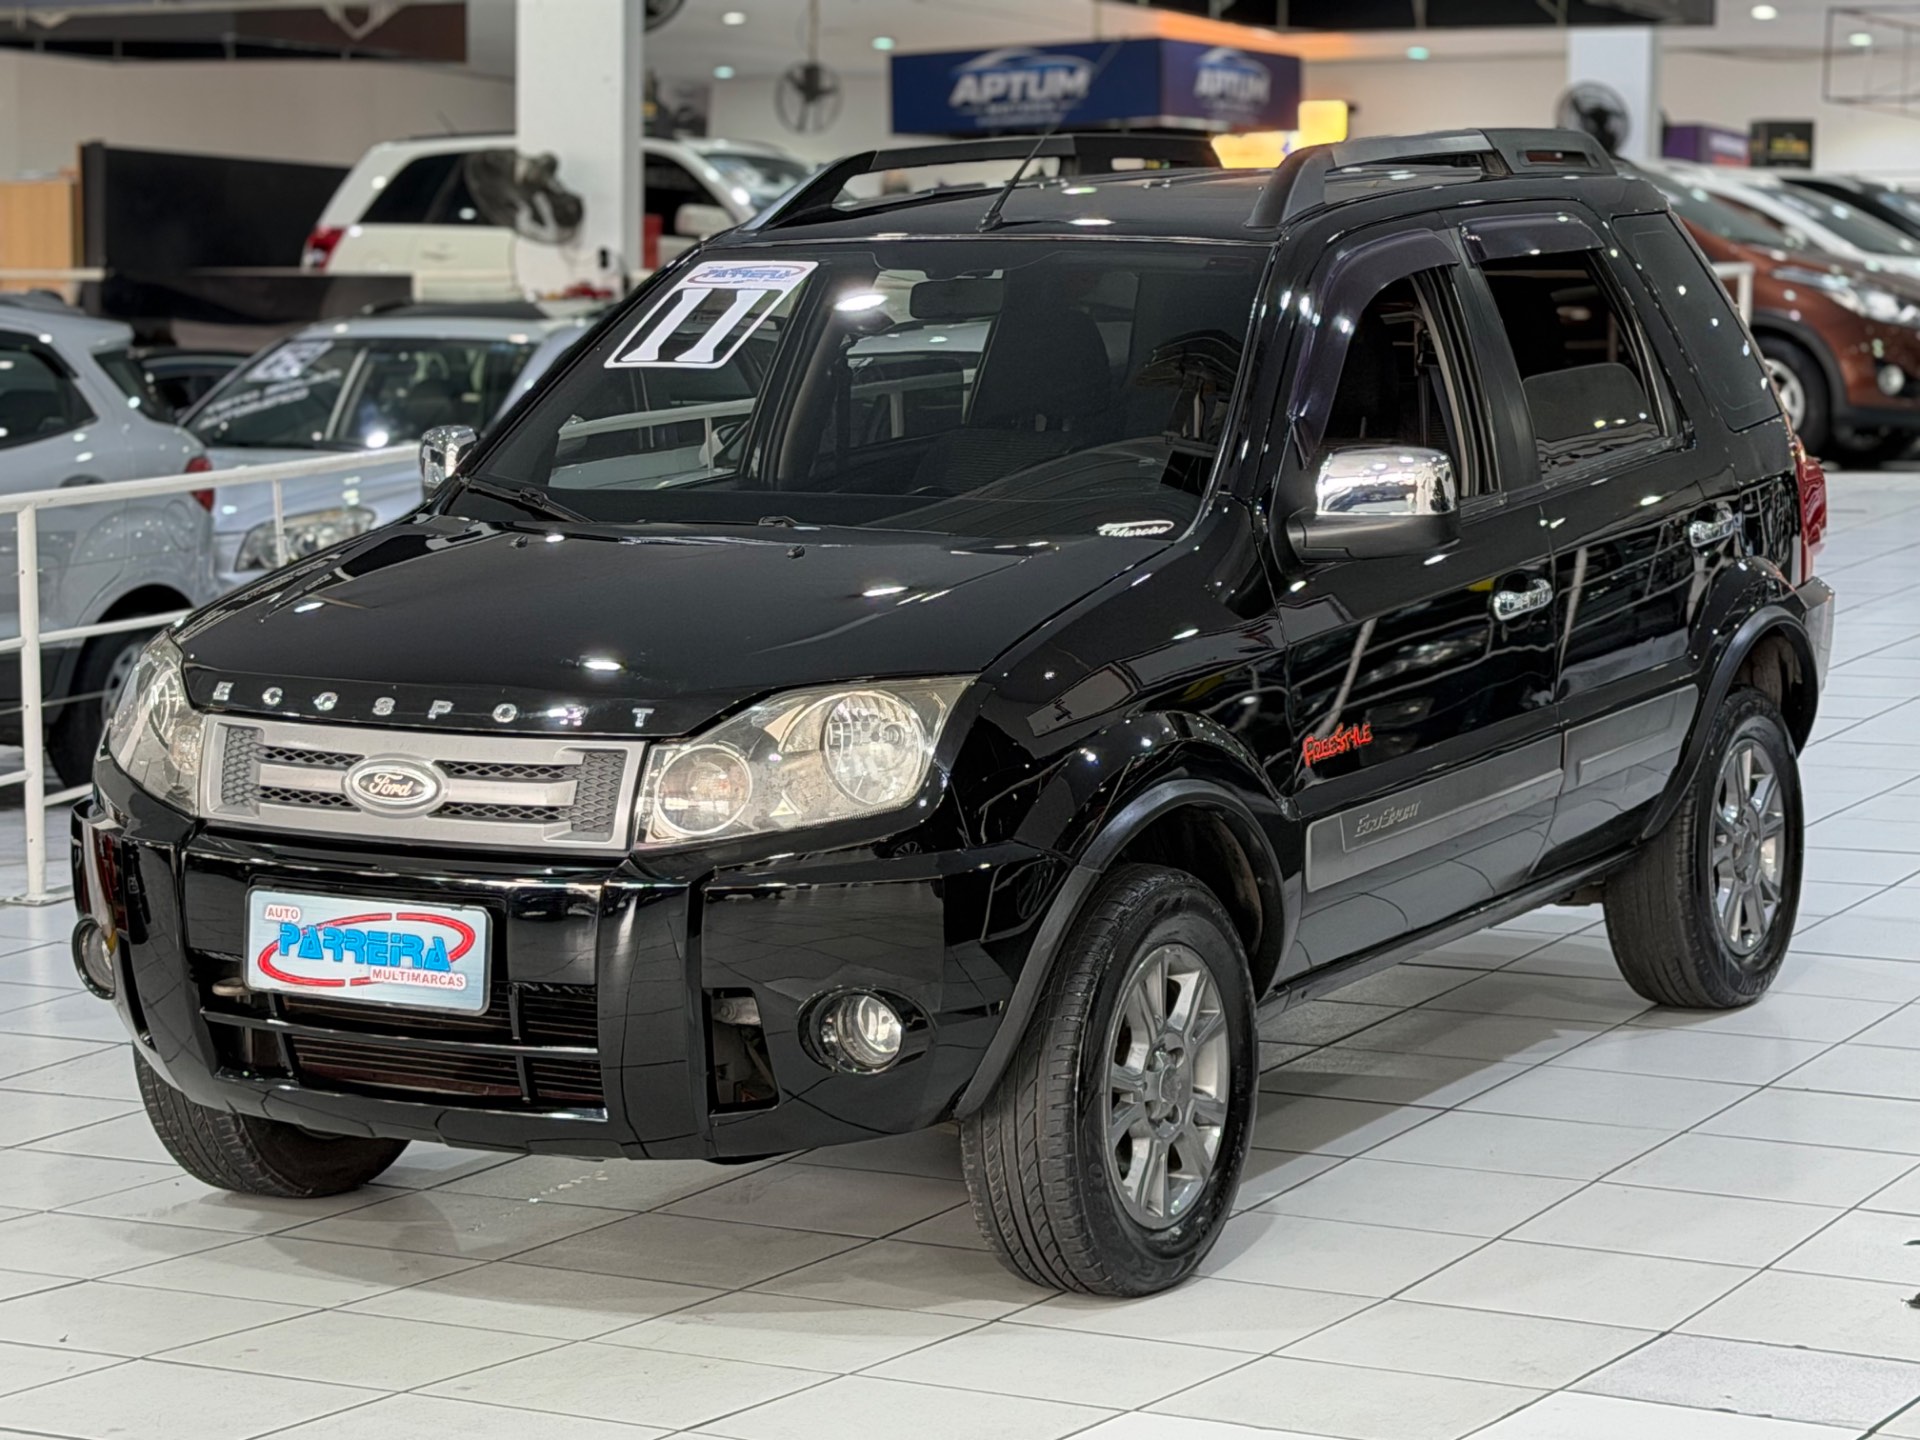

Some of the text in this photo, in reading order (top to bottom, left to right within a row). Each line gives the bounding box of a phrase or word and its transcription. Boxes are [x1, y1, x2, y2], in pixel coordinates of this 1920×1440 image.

[949, 66, 1091, 106] APTUM
[368, 772, 414, 797] Ford
[266, 906, 300, 922] AUTO
[279, 921, 451, 973] PARREIRA
[372, 968, 464, 988] MULTIMARCAS
